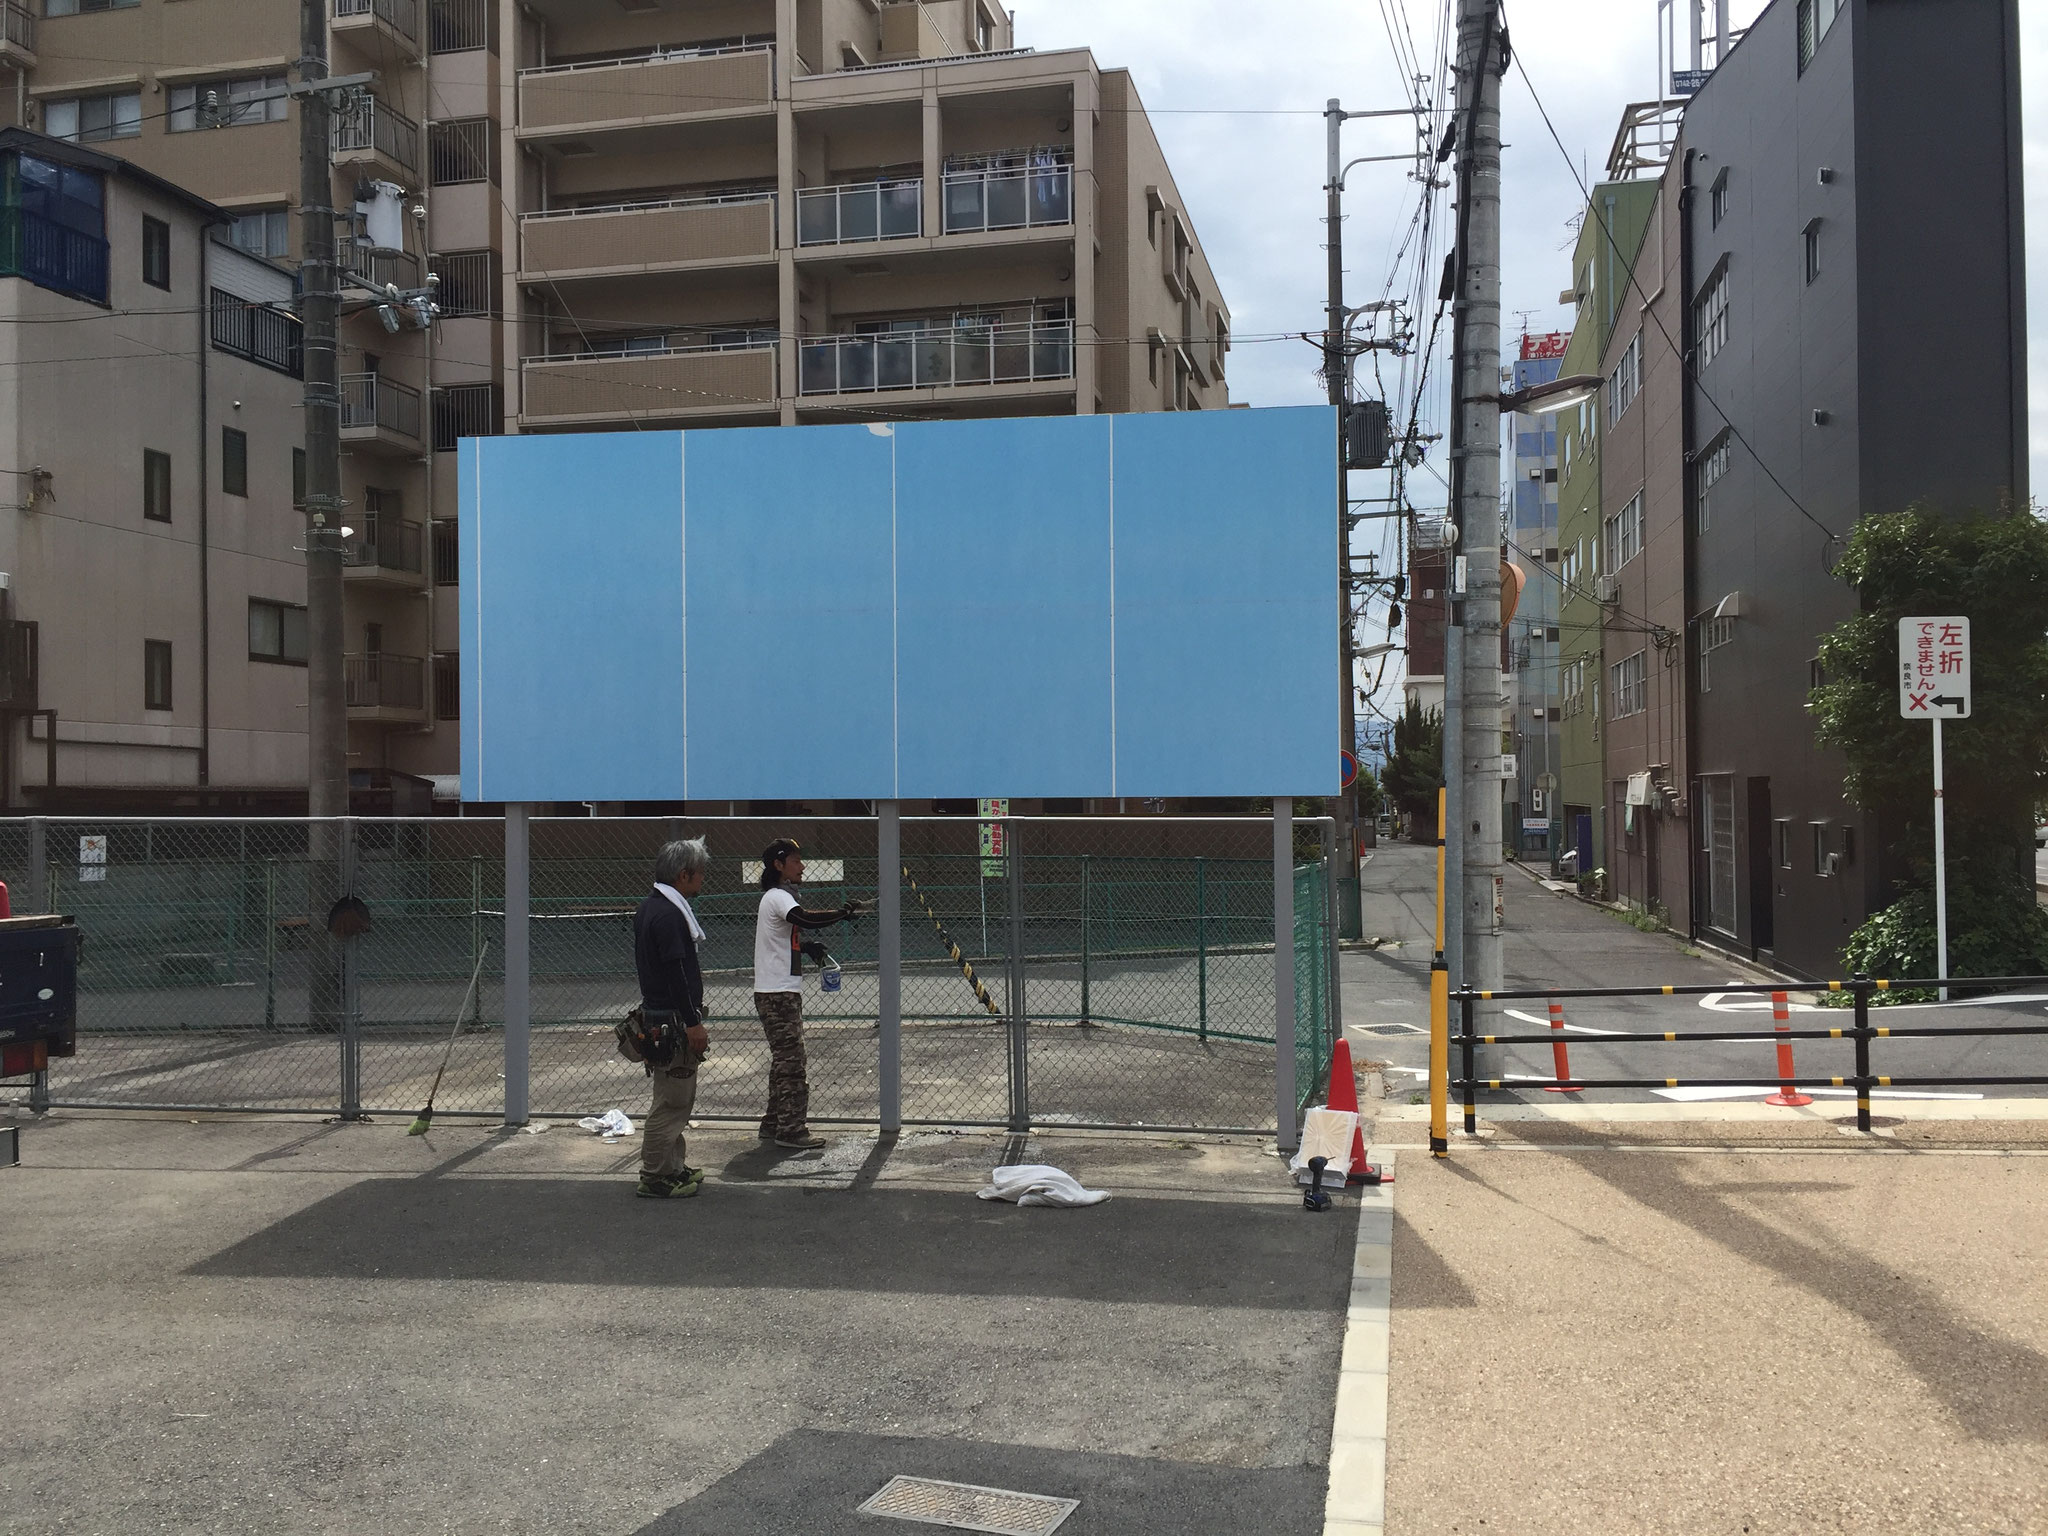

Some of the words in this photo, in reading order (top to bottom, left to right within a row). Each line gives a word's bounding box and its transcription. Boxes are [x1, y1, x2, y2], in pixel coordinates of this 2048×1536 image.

[1917, 622, 1935, 691] できません
[1939, 623, 1963, 674] 左折
[1903, 662, 1911, 690] 奈良市
